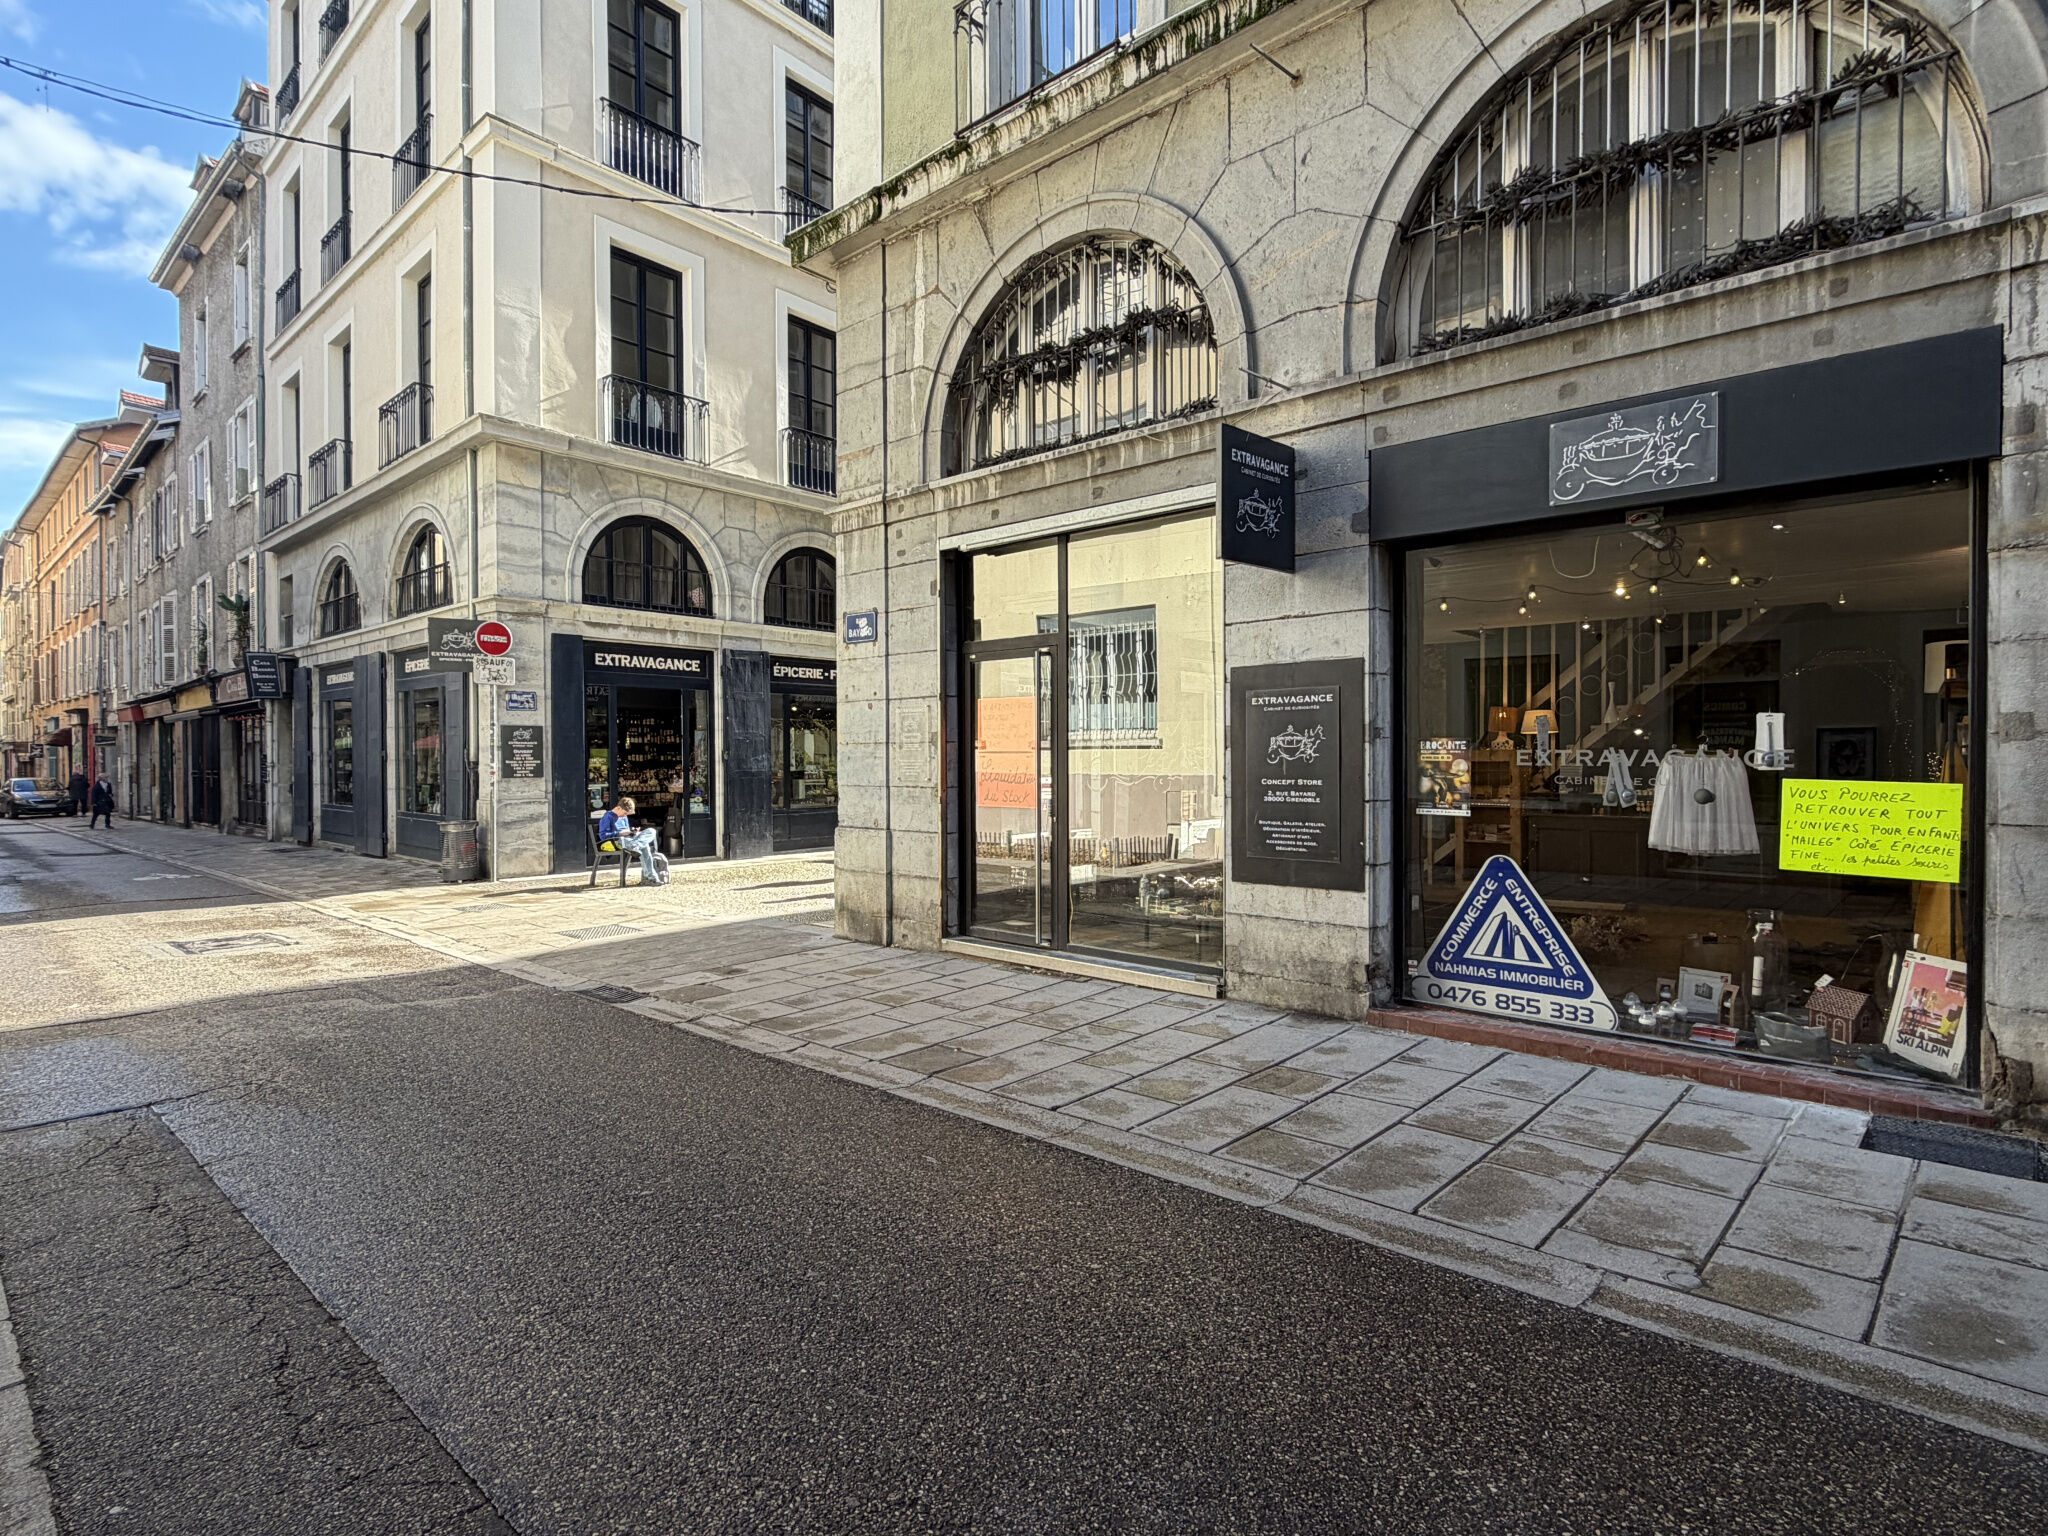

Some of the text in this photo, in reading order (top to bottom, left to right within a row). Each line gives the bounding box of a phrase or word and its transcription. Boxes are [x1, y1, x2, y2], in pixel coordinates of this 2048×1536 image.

[1231, 447, 1289, 478] EXTRAVAGANCE
[848, 627, 873, 638] BAYD
[431, 651, 486, 659] EXTRAVAGAN
[484, 658, 506, 667] SAUF
[594, 652, 701, 672] EXTRAVAGANCE
[773, 662, 824, 680] ÉPICERIE
[1251, 693, 1334, 706] EXTRAVAGANCE
[1420, 740, 1467, 750] BROCANTE
[1261, 778, 1323, 786] CONCEPT STORE
[1286, 796, 1321, 804] GRENOBLE
[1789, 786, 1916, 804] VOUS POURREZ
[1794, 803, 1949, 820] RETROUVER TOUT
[1785, 819, 1860, 834] L'UNIVERS
[1870, 824, 1904, 836] POUR
[1440, 877, 1498, 961] COMMERCE
[1504, 878, 1577, 978] ENTREPRISE
[1434, 961, 1585, 992] NAHMIAS IMMOBILIER
[1427, 983, 1595, 1025] 0476 855 333
[1896, 1030, 1951, 1059] SKI ALPIN
